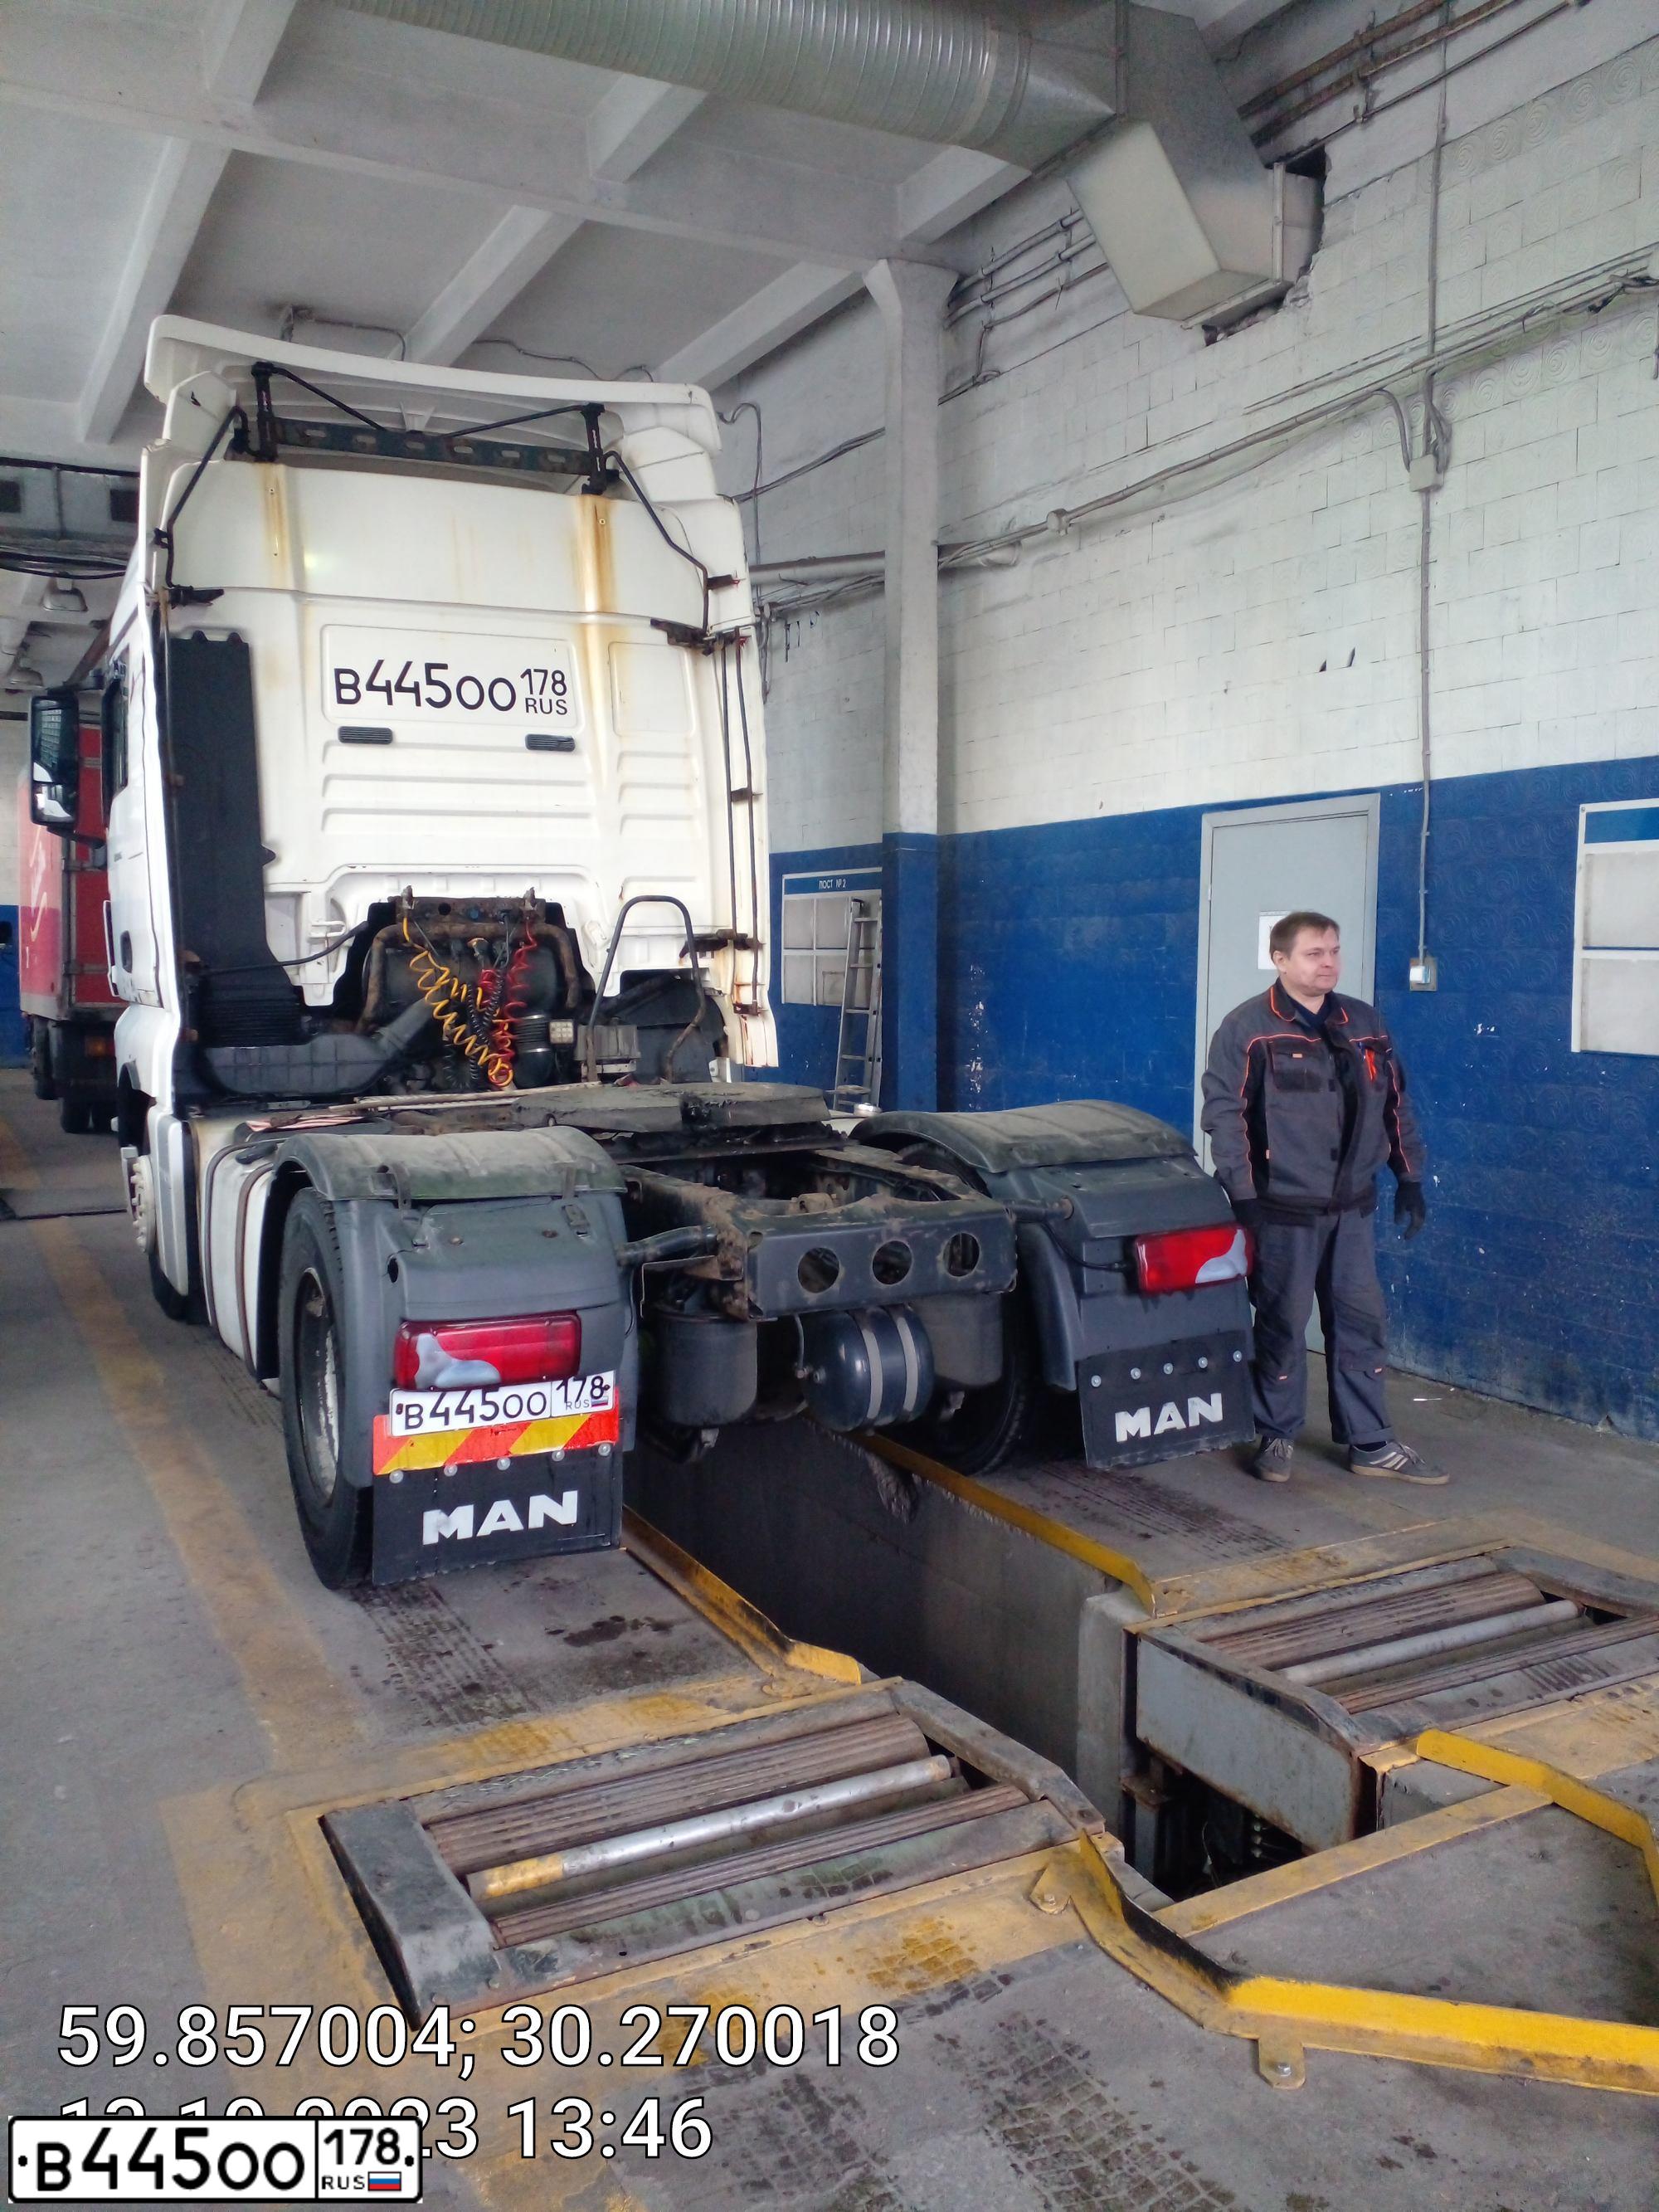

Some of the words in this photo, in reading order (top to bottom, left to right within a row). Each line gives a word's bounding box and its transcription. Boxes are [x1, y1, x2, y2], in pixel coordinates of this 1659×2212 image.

[520, 669, 567, 697] 178
[525, 697, 568, 715] RUS
[819, 879, 834, 889] ПОСТ
[556, 1375, 604, 1404] 178
[566, 1399, 590, 1411] RUS
[1115, 1393, 1224, 1442] MAN
[422, 1490, 578, 1546] MAN
